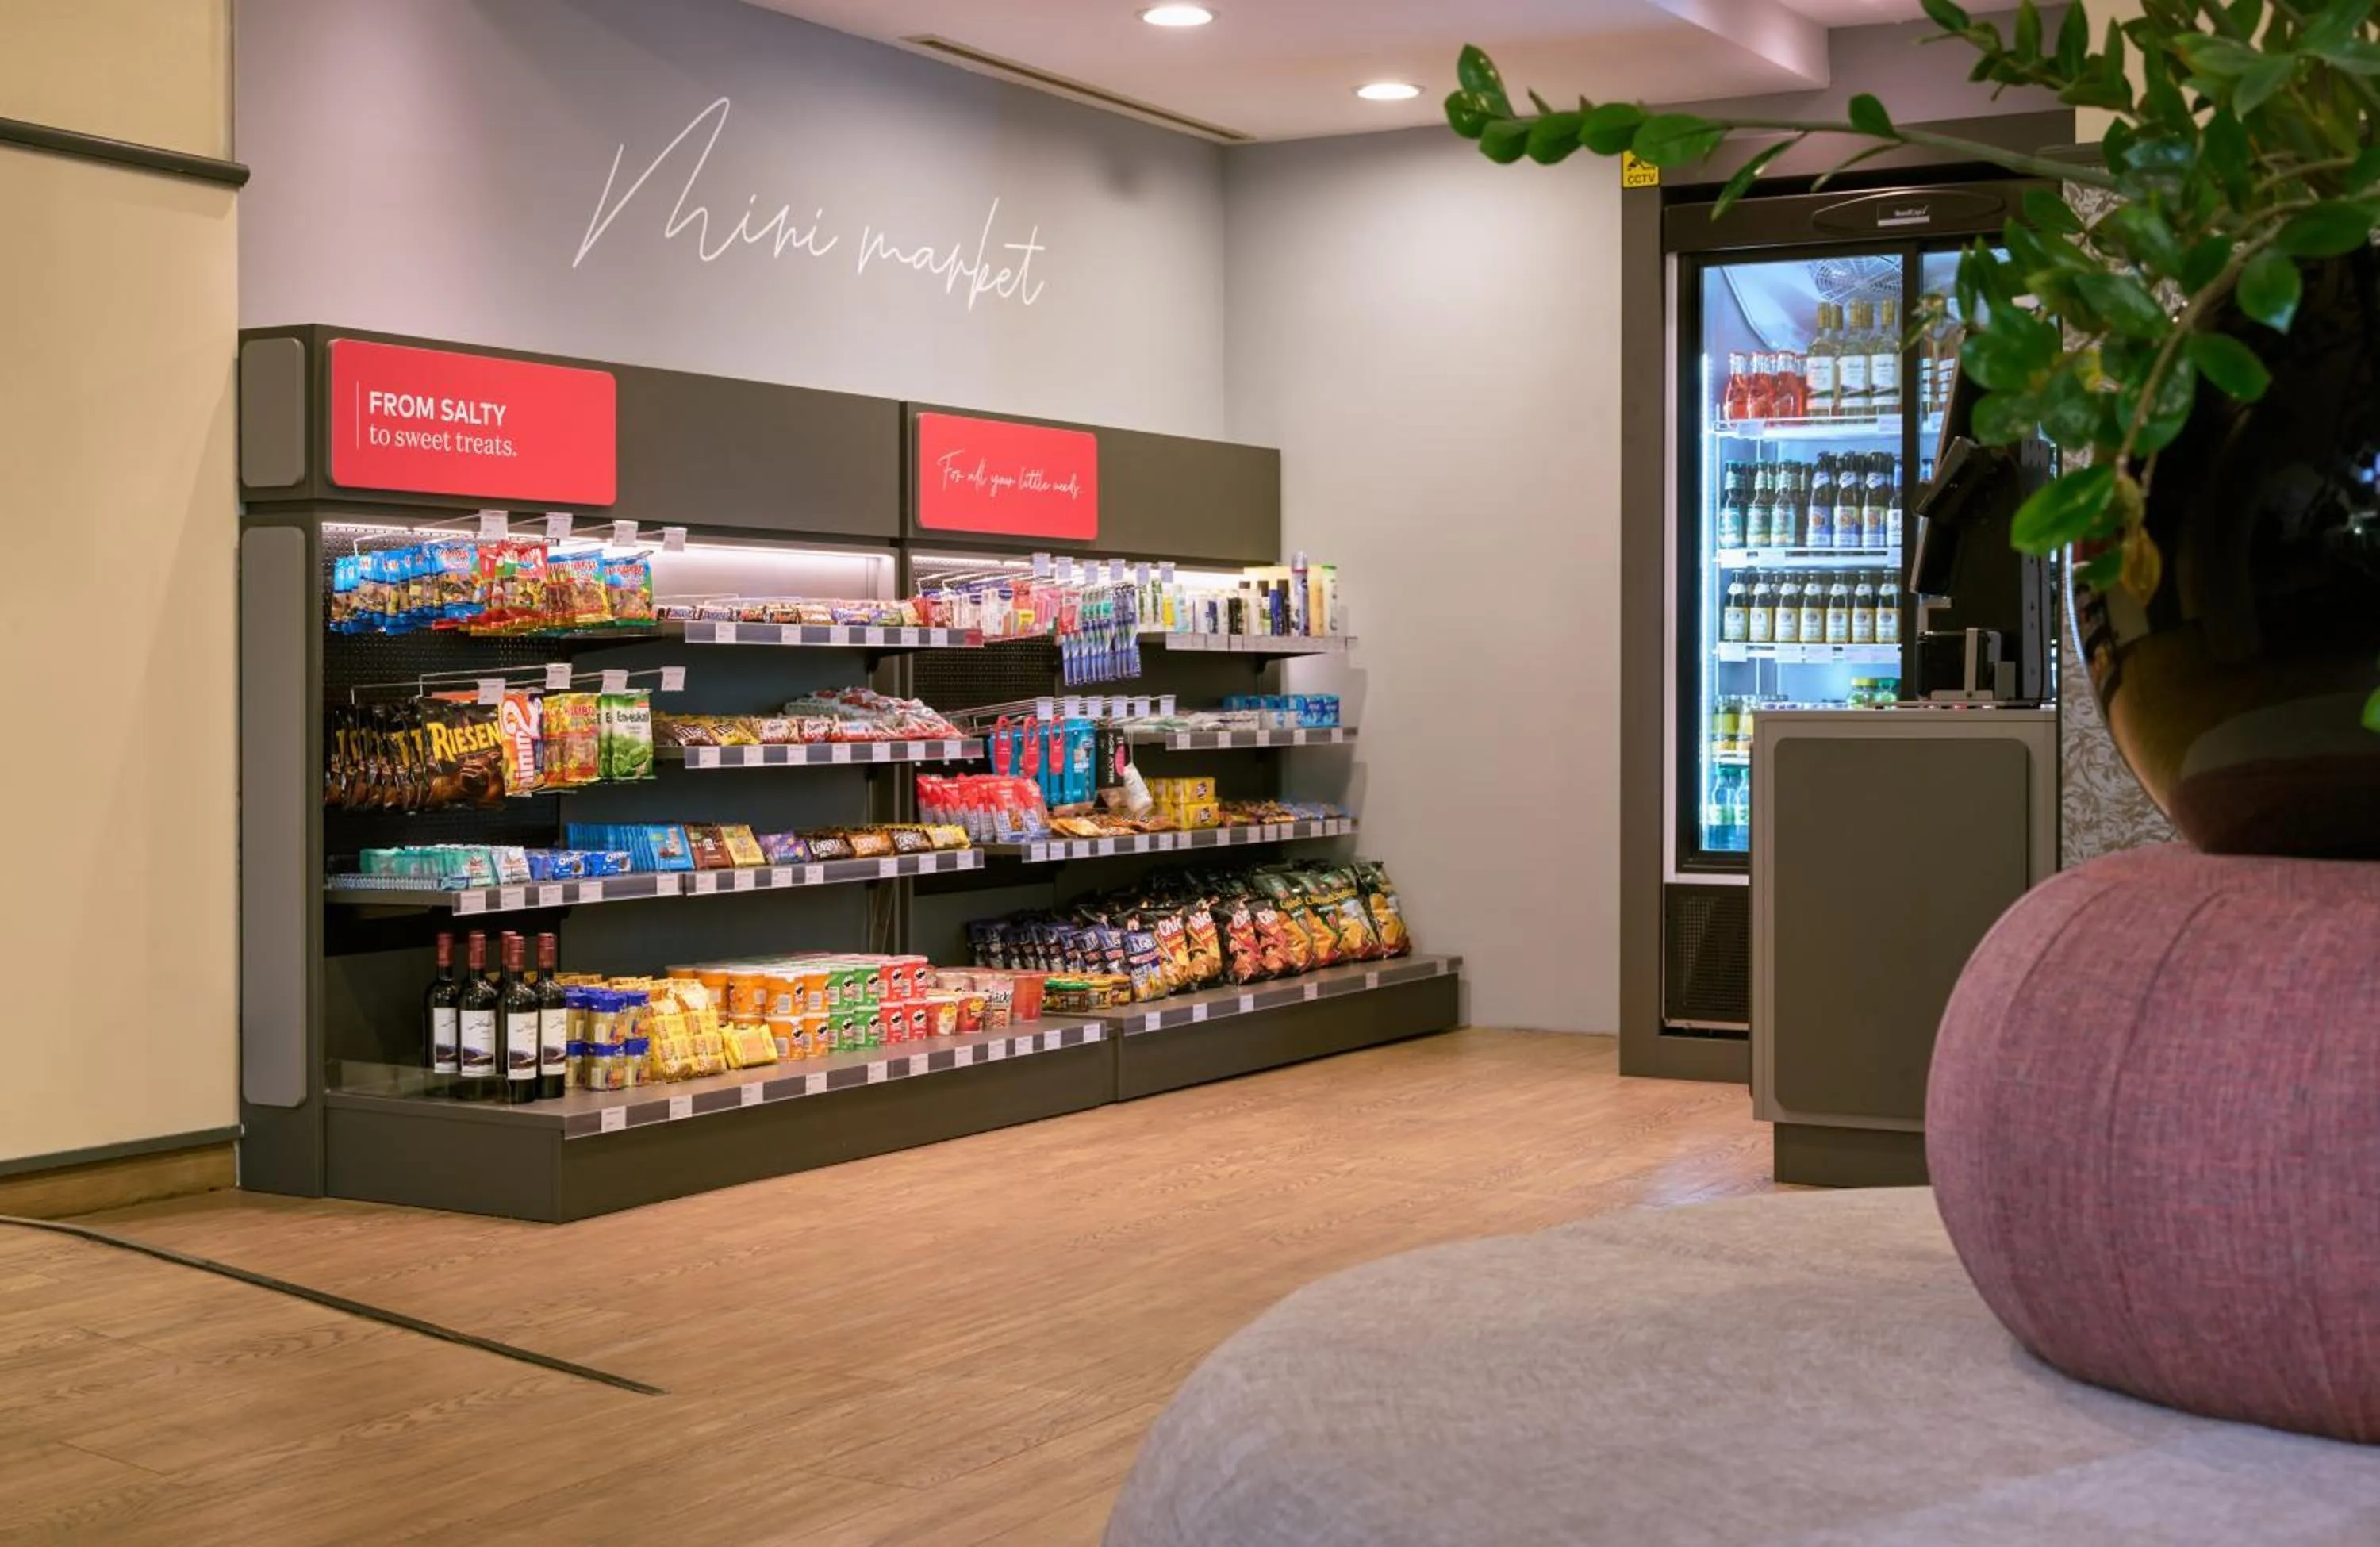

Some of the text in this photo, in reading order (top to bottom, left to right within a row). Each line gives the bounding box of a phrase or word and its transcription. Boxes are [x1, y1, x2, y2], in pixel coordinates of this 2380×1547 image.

[572, 96, 1046, 310] Mini market
[369, 390, 507, 427] FROM SALTY
[369, 423, 518, 458] to sweet treats.
[936, 449, 965, 492] For
[966, 456, 988, 492] all
[989, 474, 1016, 498] your
[1017, 465, 1051, 491] little
[426, 722, 502, 762] RIESEN
